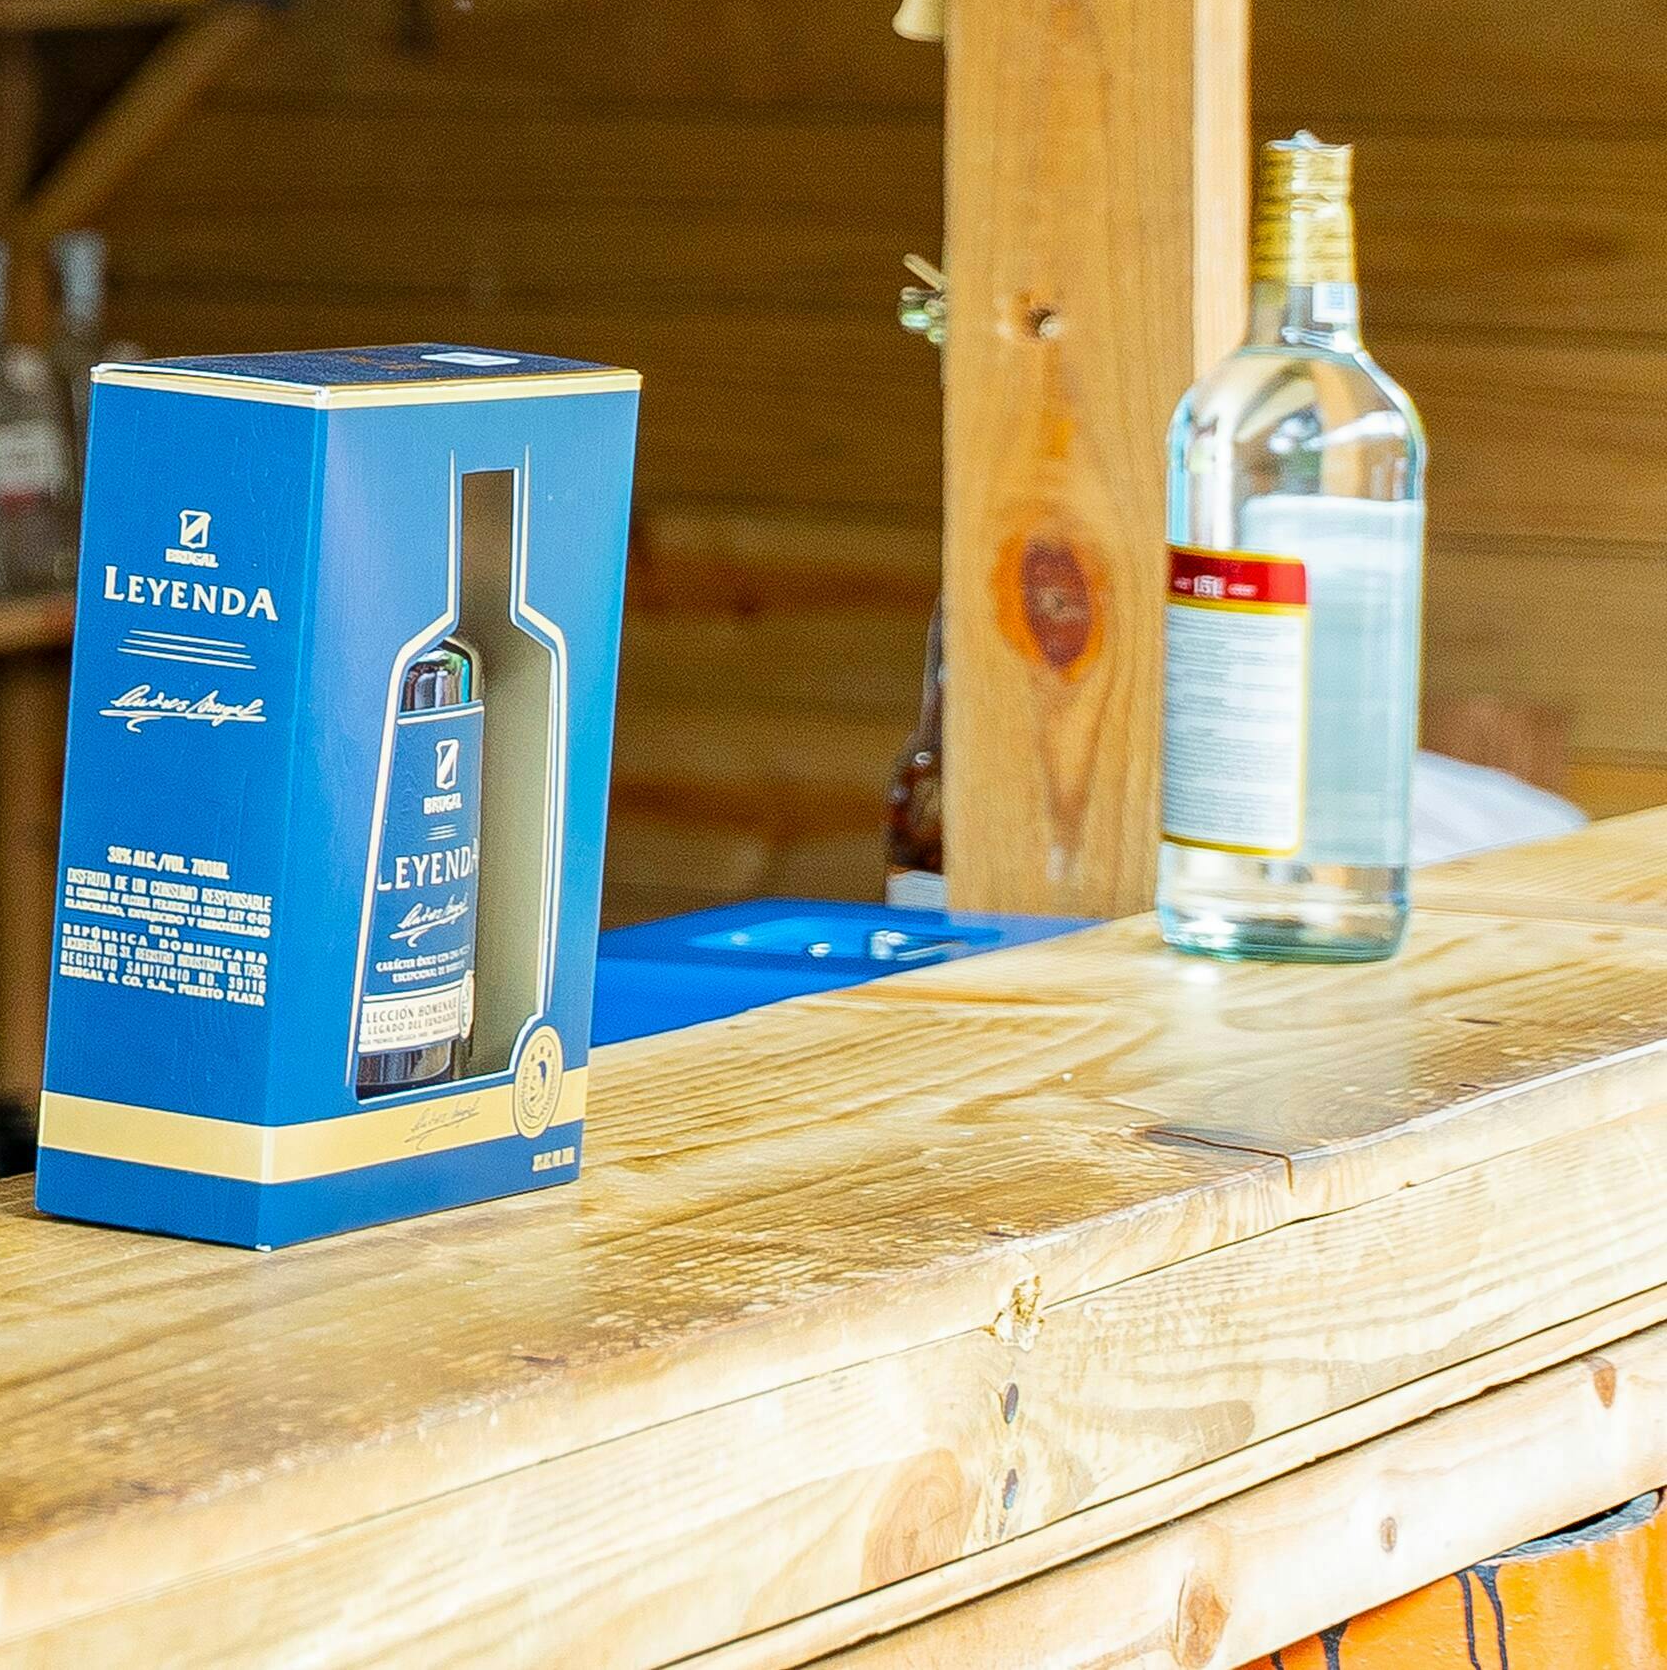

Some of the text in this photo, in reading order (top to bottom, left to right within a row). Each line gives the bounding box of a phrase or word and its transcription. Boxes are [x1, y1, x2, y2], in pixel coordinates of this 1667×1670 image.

[103, 565, 279, 621] LEYENDA
[423, 793, 462, 815] BRUGAL
[115, 875, 129, 891] DE
[159, 938, 268, 965] DOMINICANA
[60, 950, 118, 971] REGISTRO
[126, 961, 191, 983] SANITARIO
[226, 990, 265, 1007] PLATA
